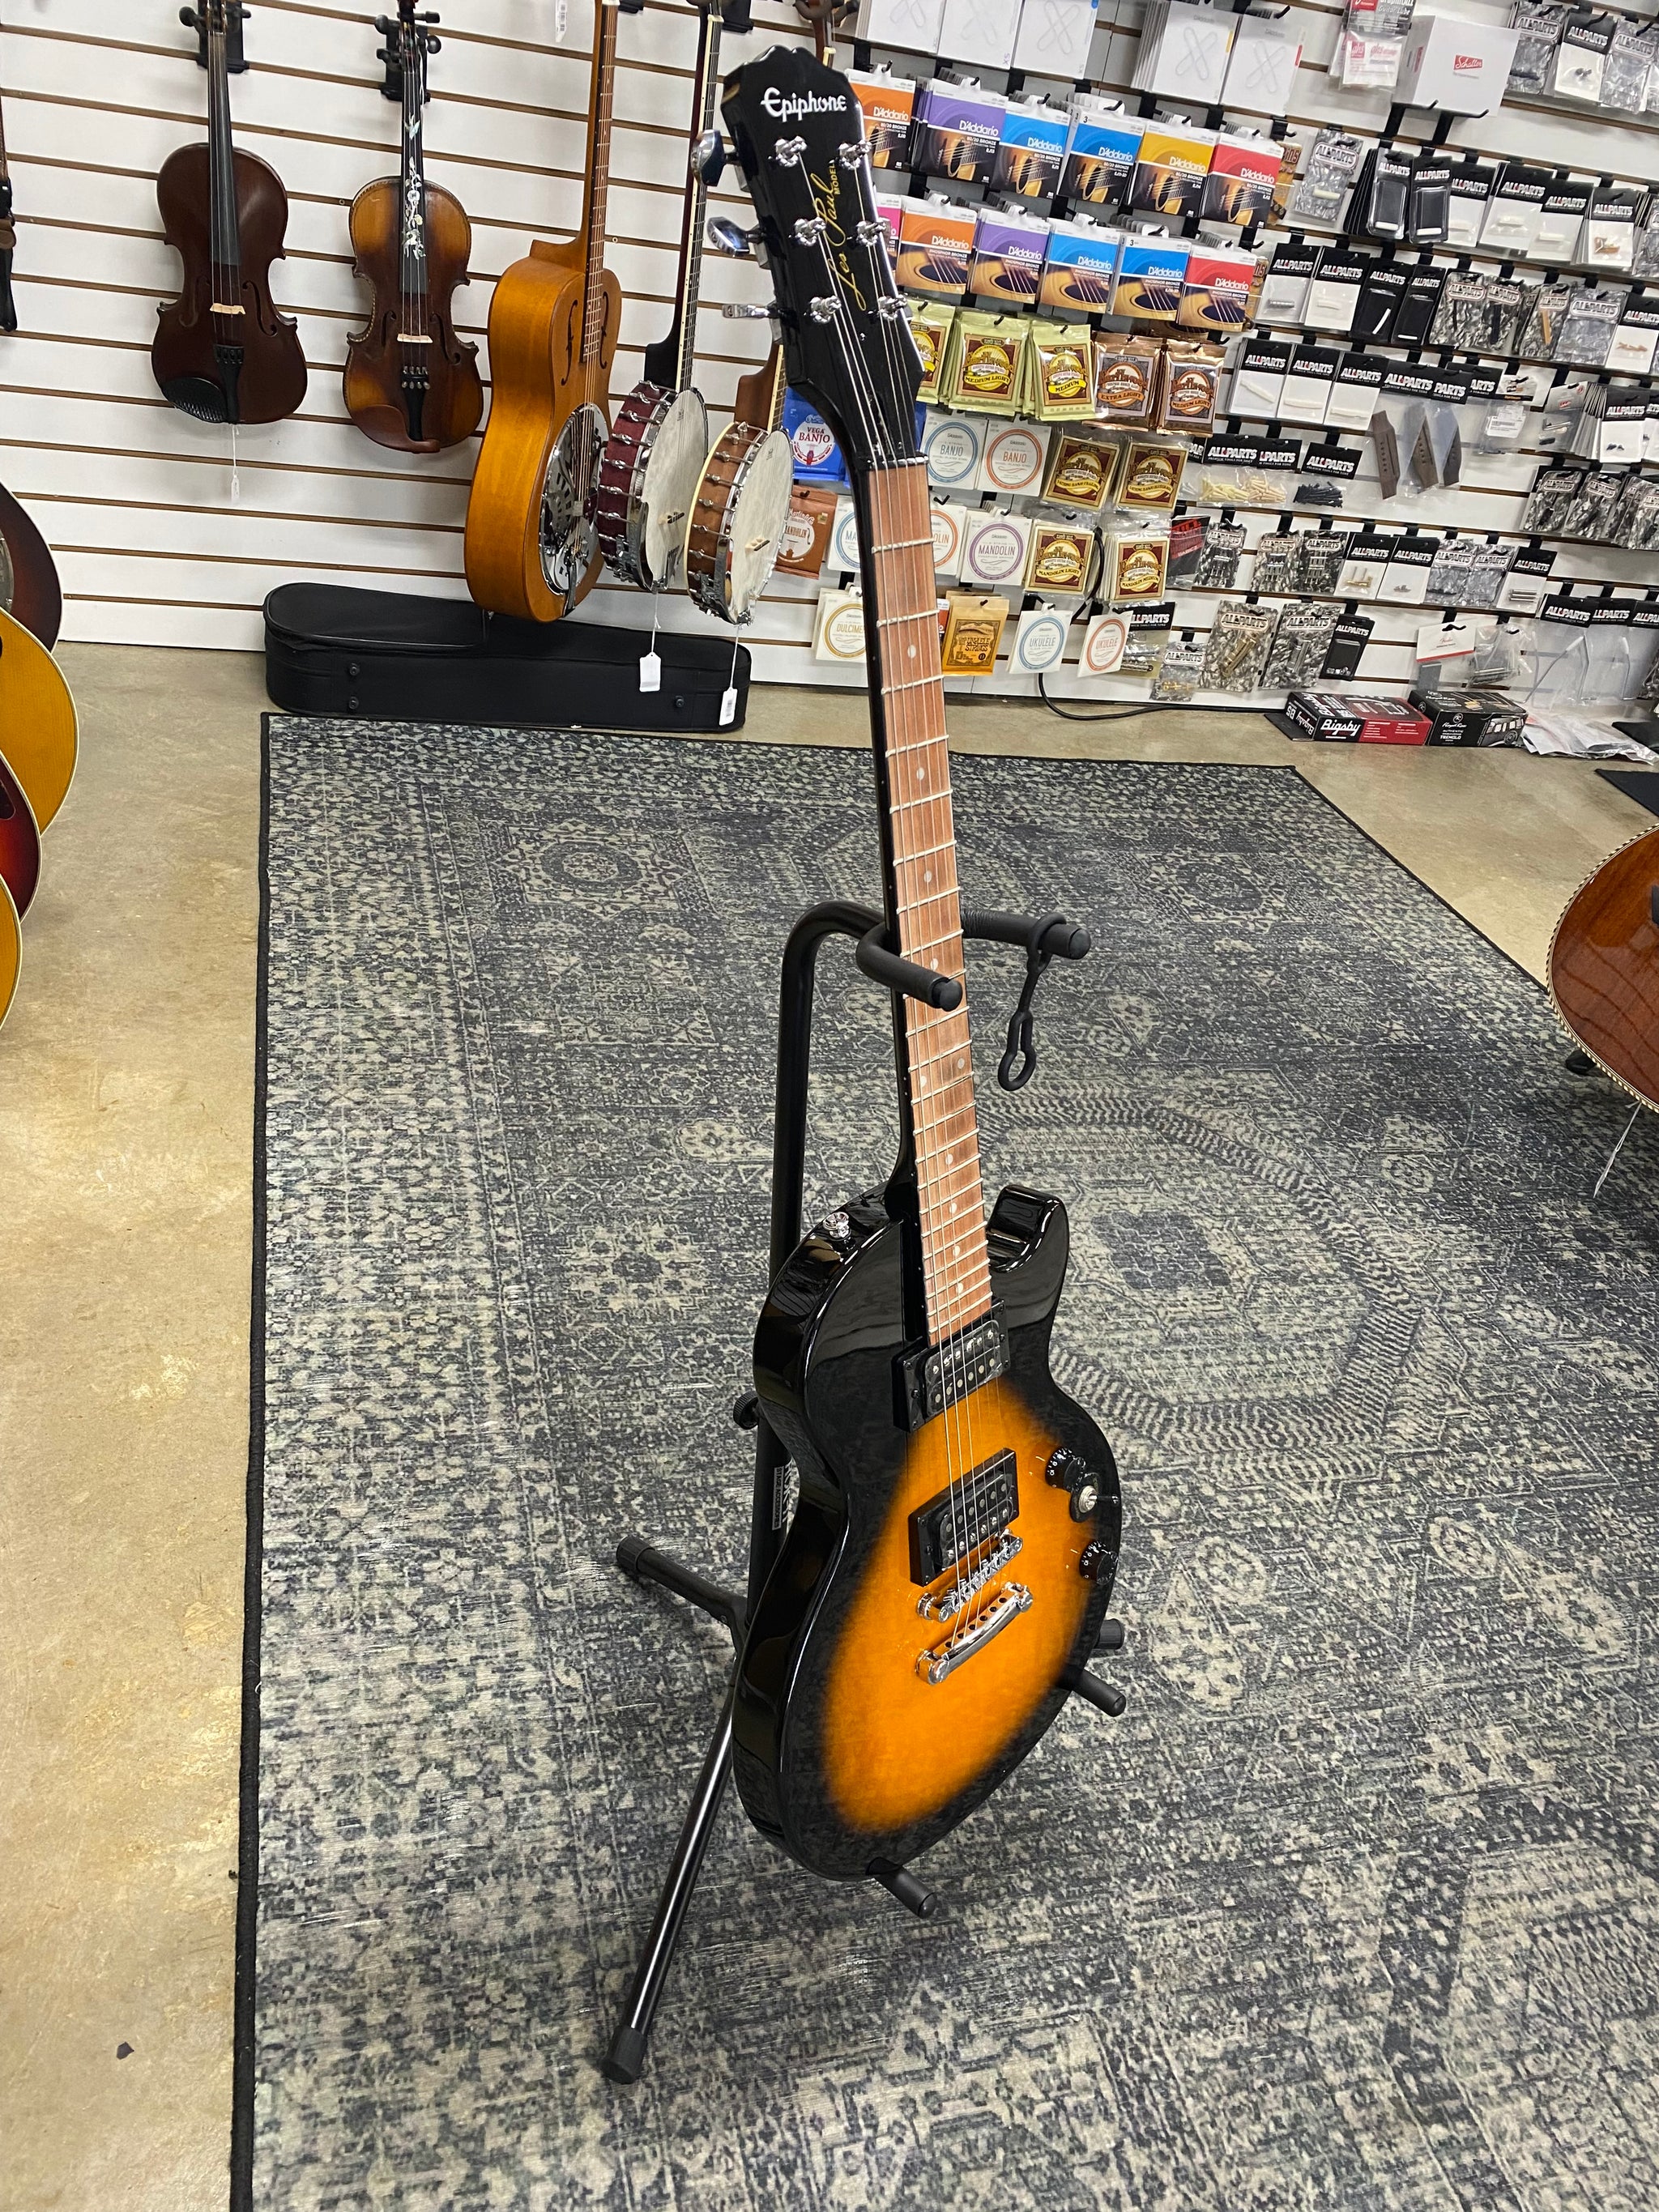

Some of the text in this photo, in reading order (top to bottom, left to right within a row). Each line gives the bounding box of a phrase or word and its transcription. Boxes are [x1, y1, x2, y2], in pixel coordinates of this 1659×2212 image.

[1518, 17, 1559, 35] ALLPARTS
[1567, 26, 1609, 46] ALLPARTS
[760, 87, 847, 121] Epiphone
[873, 107, 908, 121] D'Addario
[959, 120, 999, 136] D'Addario
[1028, 137, 1062, 152] D'Addario
[1098, 147, 1133, 161] D'Addario
[1316, 146, 1357, 164] ALLPARTS
[1170, 156, 1205, 172] D'Addario
[1378, 162, 1410, 176] ALLPARTS
[829, 162, 841, 195] MODEL
[1241, 168, 1275, 184] D'Addario
[1414, 169, 1450, 180] ALLPARTS
[1502, 181, 1546, 197] ALLPARTS
[1546, 196, 1586, 211] ALLPARTS
[1594, 203, 1633, 216] ALLPARTS
[932, 236, 969, 249] D'Addario
[1009, 246, 1042, 260] D'Addario
[1077, 256, 1111, 270] D'Addario
[1273, 259, 1313, 271] ALLPARTS
[1148, 266, 1183, 278] D'Addario
[1320, 265, 1363, 279] ALLPARTS
[1370, 271, 1405, 285] ALLPARTS
[1215, 277, 1249, 291] D'Addario
[1412, 277, 1440, 288] ALLPARTS
[1572, 300, 1618, 316] ALLPARTS
[1245, 355, 1286, 368] ALLPARTS
[1293, 360, 1334, 374] ALLPARTS
[992, 375, 1009, 384] LIGHT
[1341, 368, 1382, 381] ALLPARTS
[1055, 380, 1080, 392] MEDIUM
[1384, 373, 1433, 390] ALLPARTS
[1471, 379, 1495, 392] ARTS
[1434, 382, 1466, 397] PARTS
[1606, 406, 1645, 416] ALLPARTS
[808, 426, 825, 434] VEGA
[798, 432, 830, 443] BANJO
[940, 445, 963, 456] BANJO
[1004, 452, 1026, 462] BANJO
[1208, 446, 1257, 460] ALLPARTS
[1259, 450, 1296, 463] LPARTS
[1307, 455, 1354, 472] ALLPARTS
[979, 544, 1015, 556] MANDOLIN
[1307, 540, 1341, 551] ALLPARTS
[1351, 548, 1389, 559] ALLPARTS
[1394, 550, 1433, 562] ALLPARTS
[1477, 556, 1508, 567] ALLPARTS
[1515, 560, 1550, 571] ALLPARTS
[1130, 614, 1170, 624] LLPARTS
[1545, 606, 1591, 621] ALLPARTS
[1593, 609, 1631, 620] LLPARTS
[1632, 612, 1659, 623] ALLPA
[1222, 613, 1268, 629] ALLPARTS
[1286, 616, 1329, 628] ALLPARTS
[836, 623, 864, 633] DULCIME
[1336, 623, 1369, 636] ALLPARTS
[1030, 636, 1056, 647] UKULELE
[1096, 637, 1118, 648] UKULELE
[1165, 652, 1203, 663] ALLPARTS
[1296, 711, 1315, 735] Bigsby
[1320, 718, 1361, 736] Bigsby
